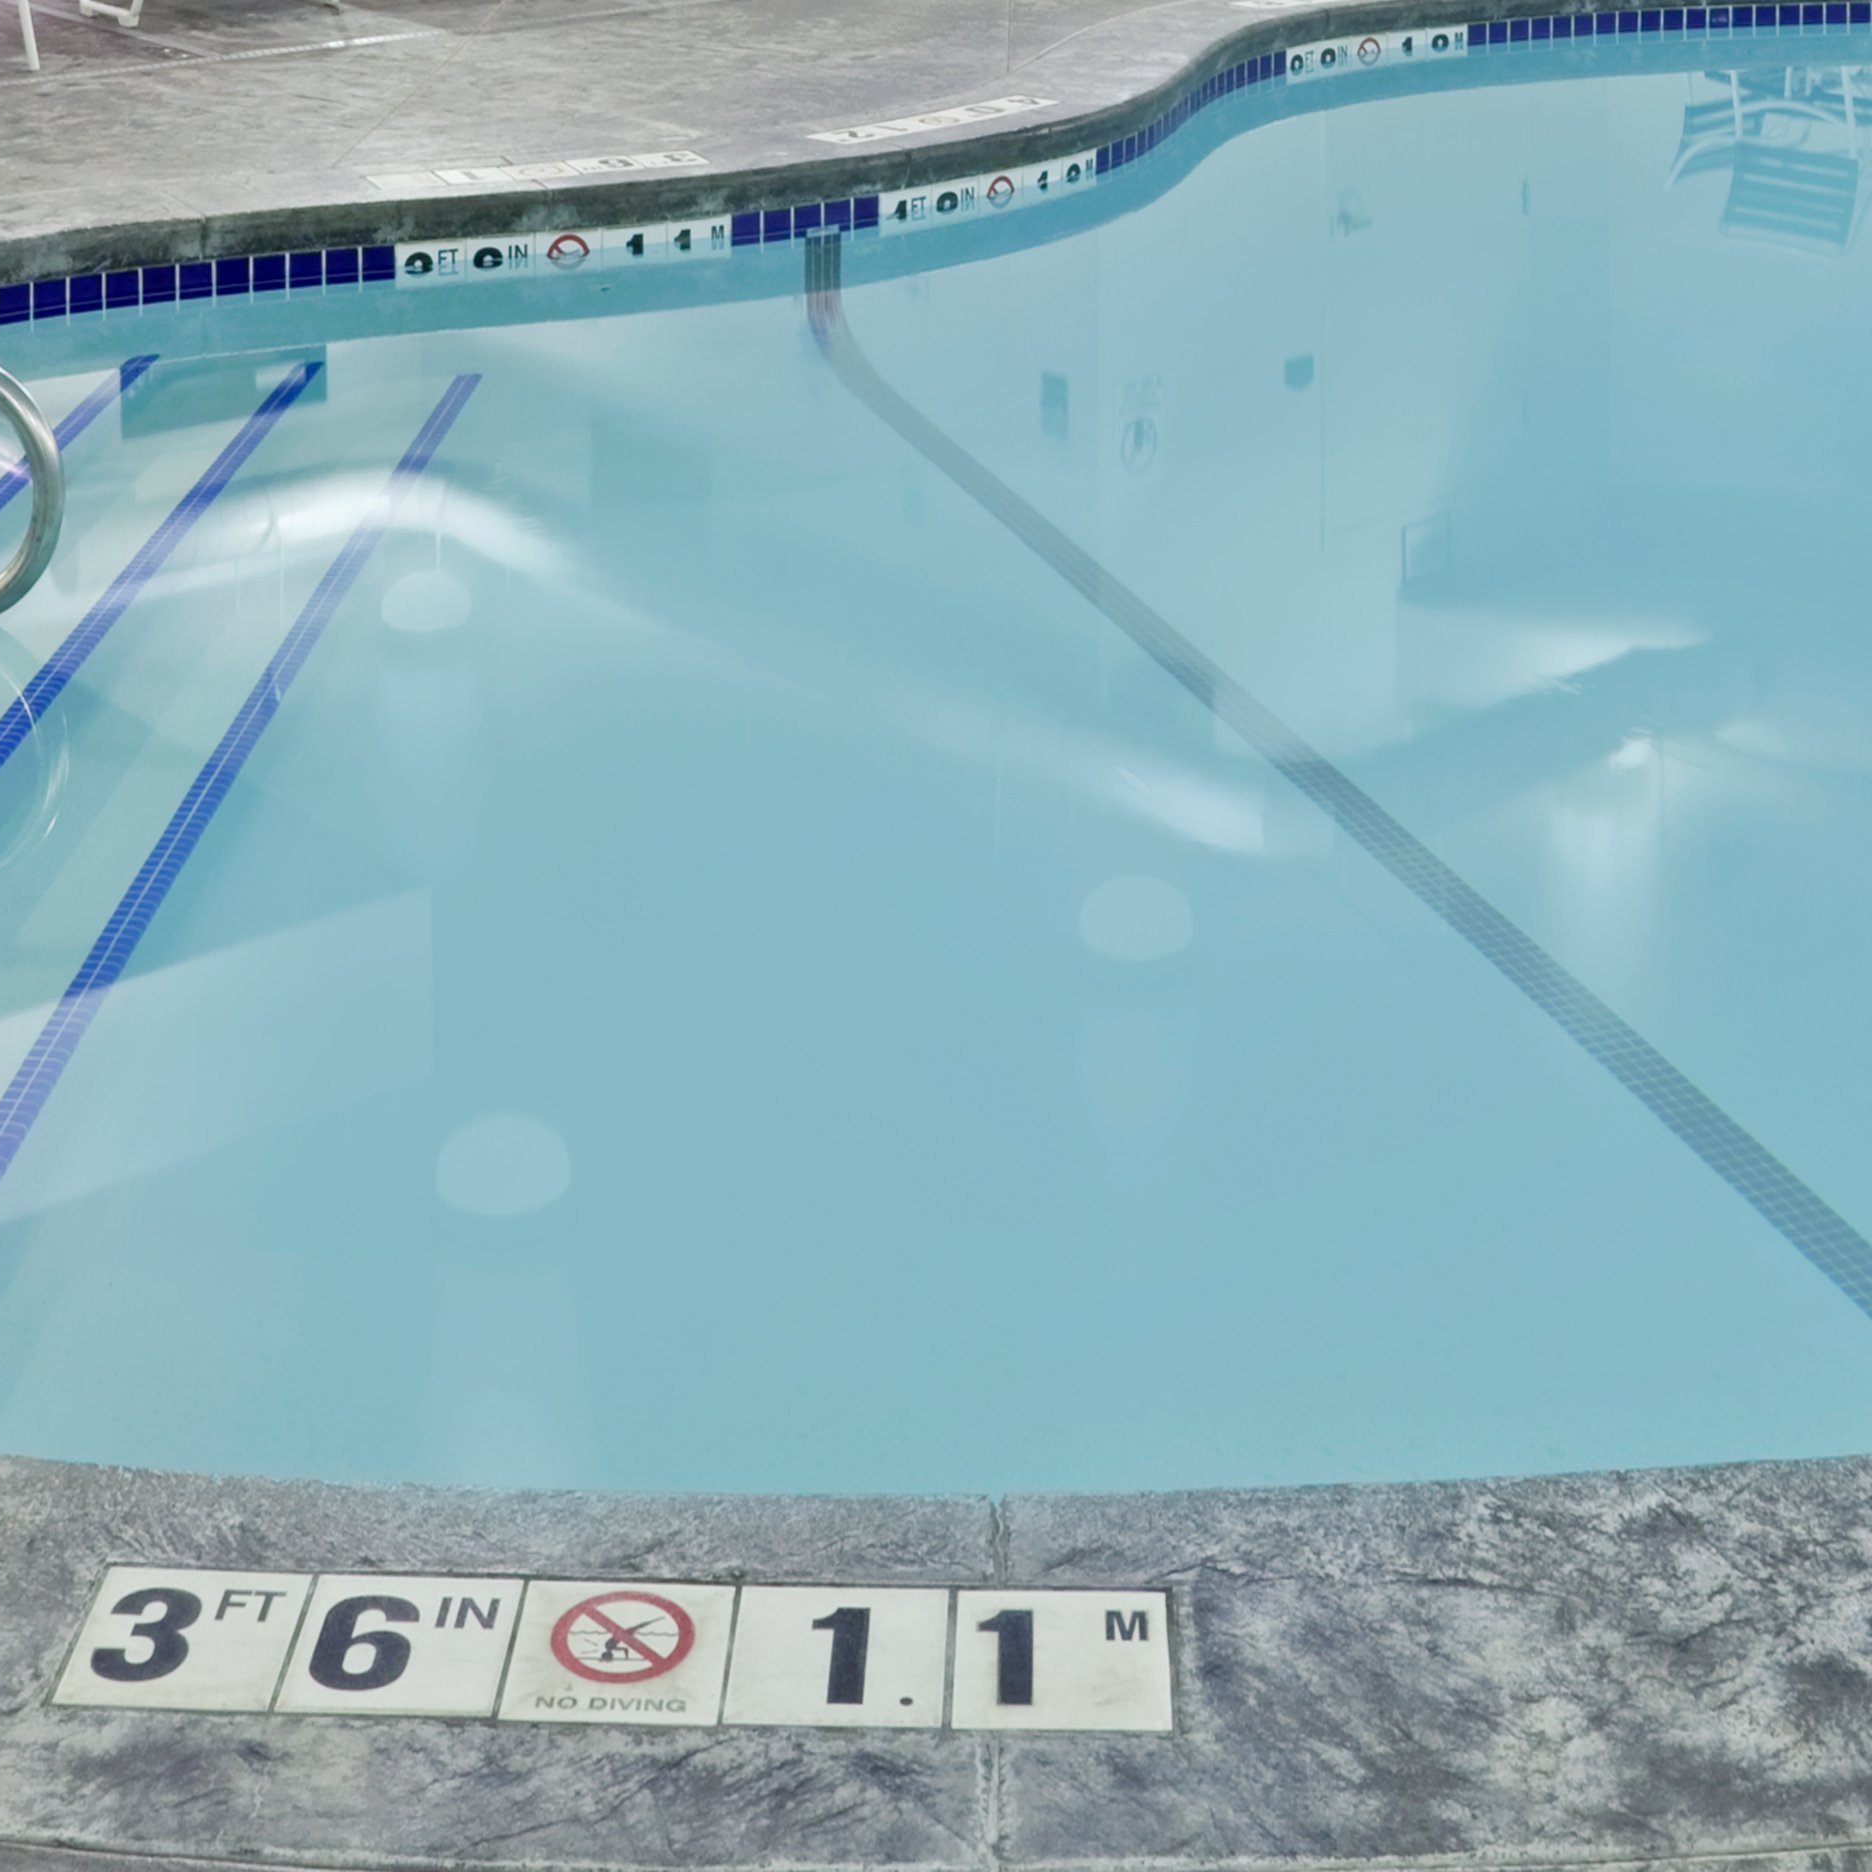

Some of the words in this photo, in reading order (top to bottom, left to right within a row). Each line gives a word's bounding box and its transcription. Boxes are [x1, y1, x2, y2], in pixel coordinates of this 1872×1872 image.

[90, 1587, 202, 1682] 3
[214, 1589, 287, 1622] FT
[308, 1595, 421, 1691] 6
[433, 1597, 500, 1630] IN
[1104, 1611, 1149, 1641] M
[534, 1696, 579, 1712] NO
[587, 1697, 688, 1713] DIVING
